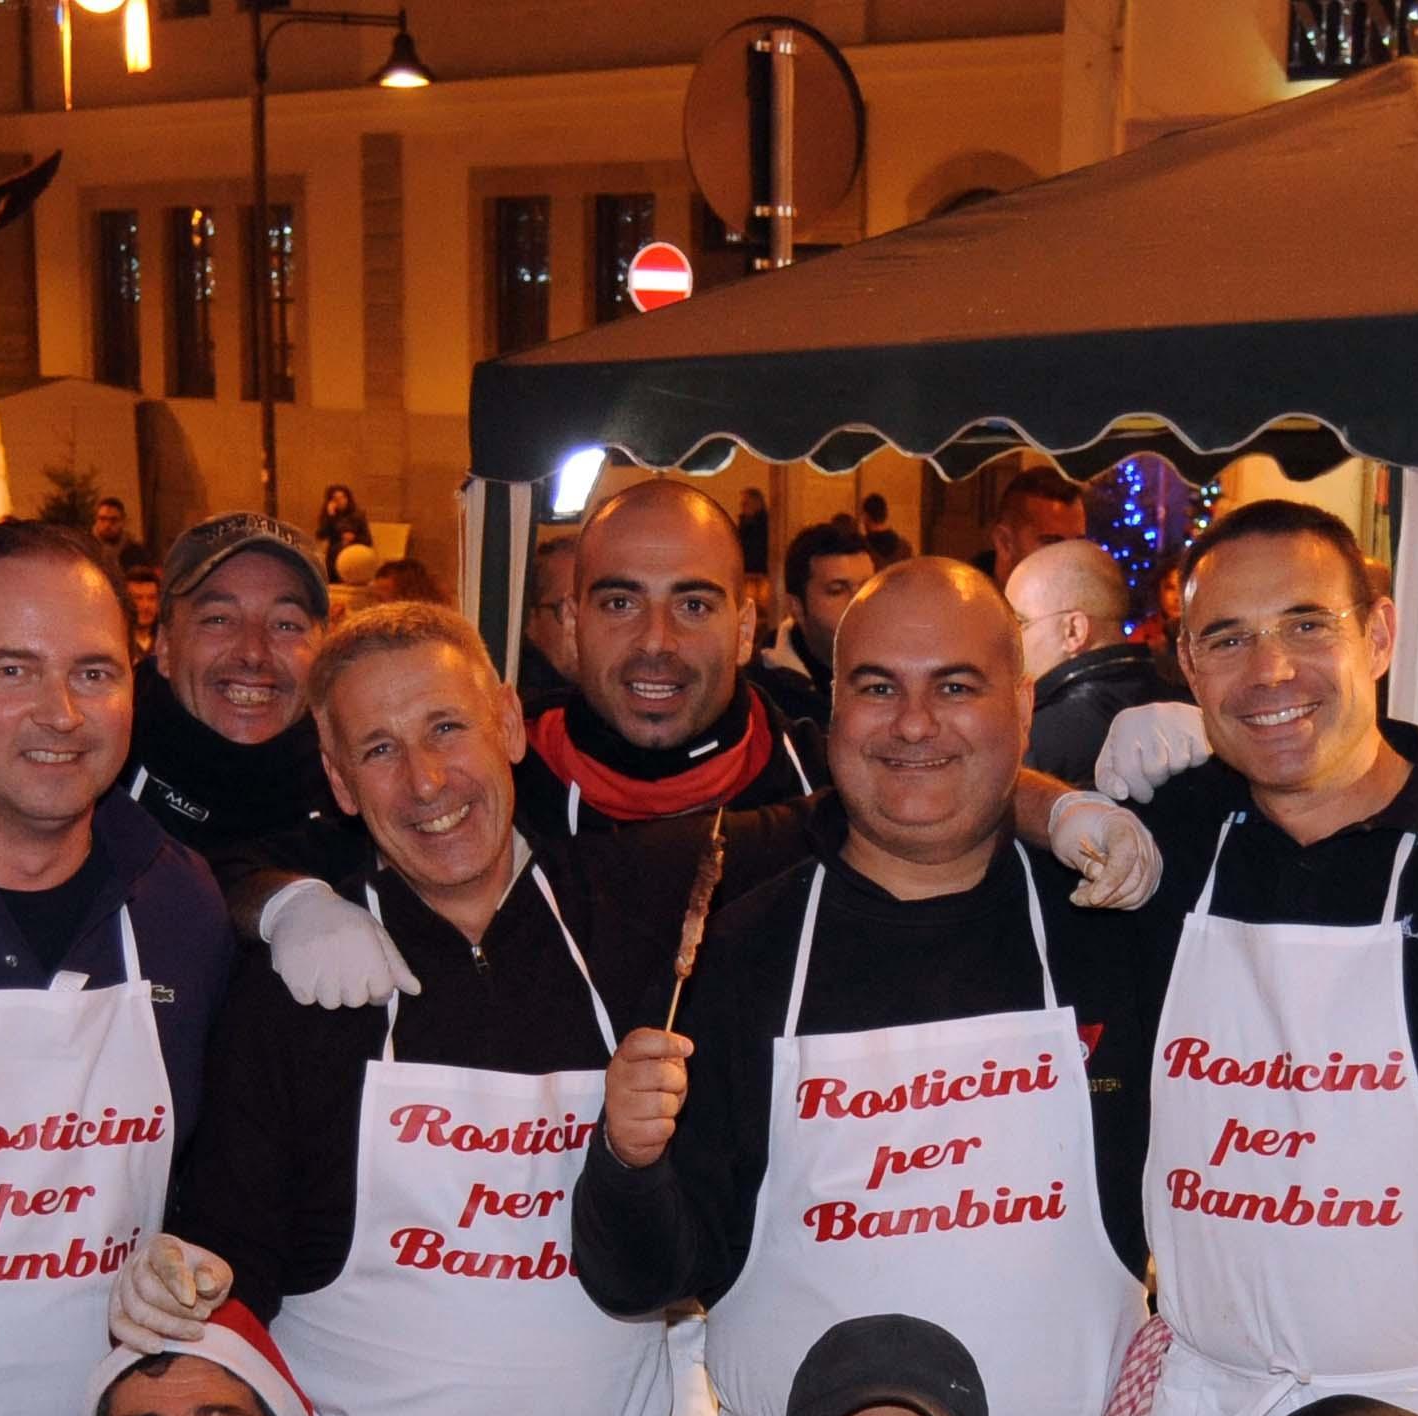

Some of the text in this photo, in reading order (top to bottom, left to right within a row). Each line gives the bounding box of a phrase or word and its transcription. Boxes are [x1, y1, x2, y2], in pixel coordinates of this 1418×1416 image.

[796, 1052, 1058, 1120] Rosticini
[1164, 1035, 1404, 1092] Rosticini
[867, 1136, 982, 1193] per
[1210, 1117, 1317, 1167] per
[457, 1182, 565, 1229] per
[803, 1177, 1065, 1243] Bambini
[1168, 1167, 1402, 1227] Bambini
[389, 1223, 577, 1281] Bamb
